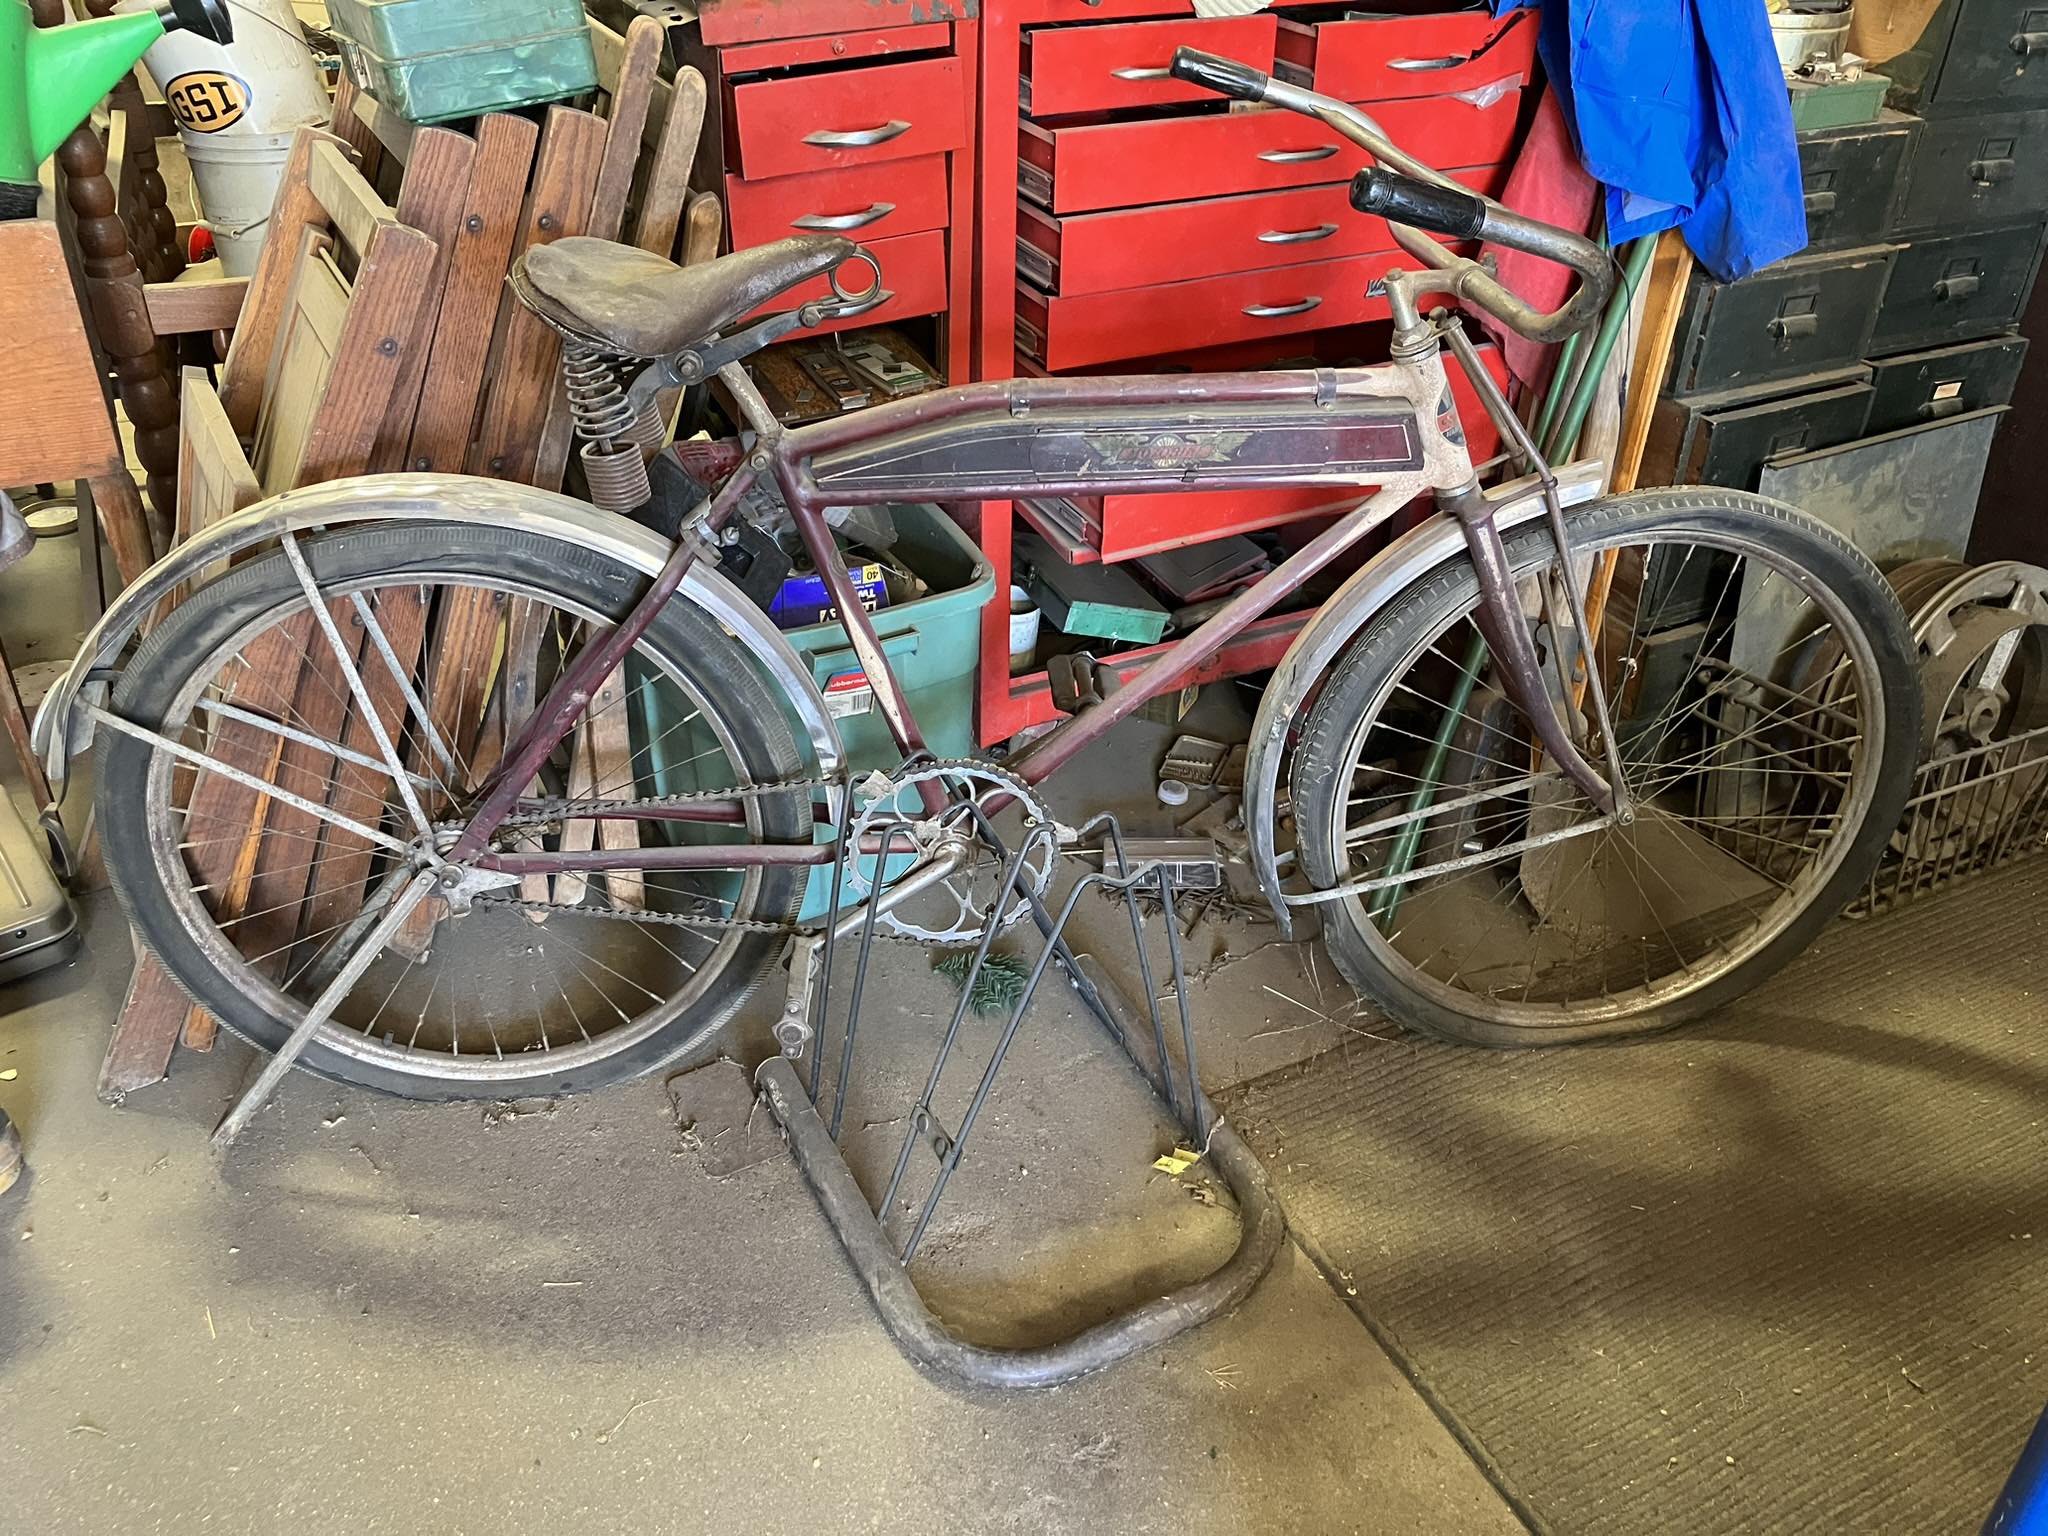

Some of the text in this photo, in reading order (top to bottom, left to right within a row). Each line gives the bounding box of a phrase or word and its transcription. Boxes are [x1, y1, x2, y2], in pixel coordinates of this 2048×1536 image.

[171, 81, 238, 122] GSI
[866, 571, 879, 580] 40
[858, 588, 876, 599] TW
